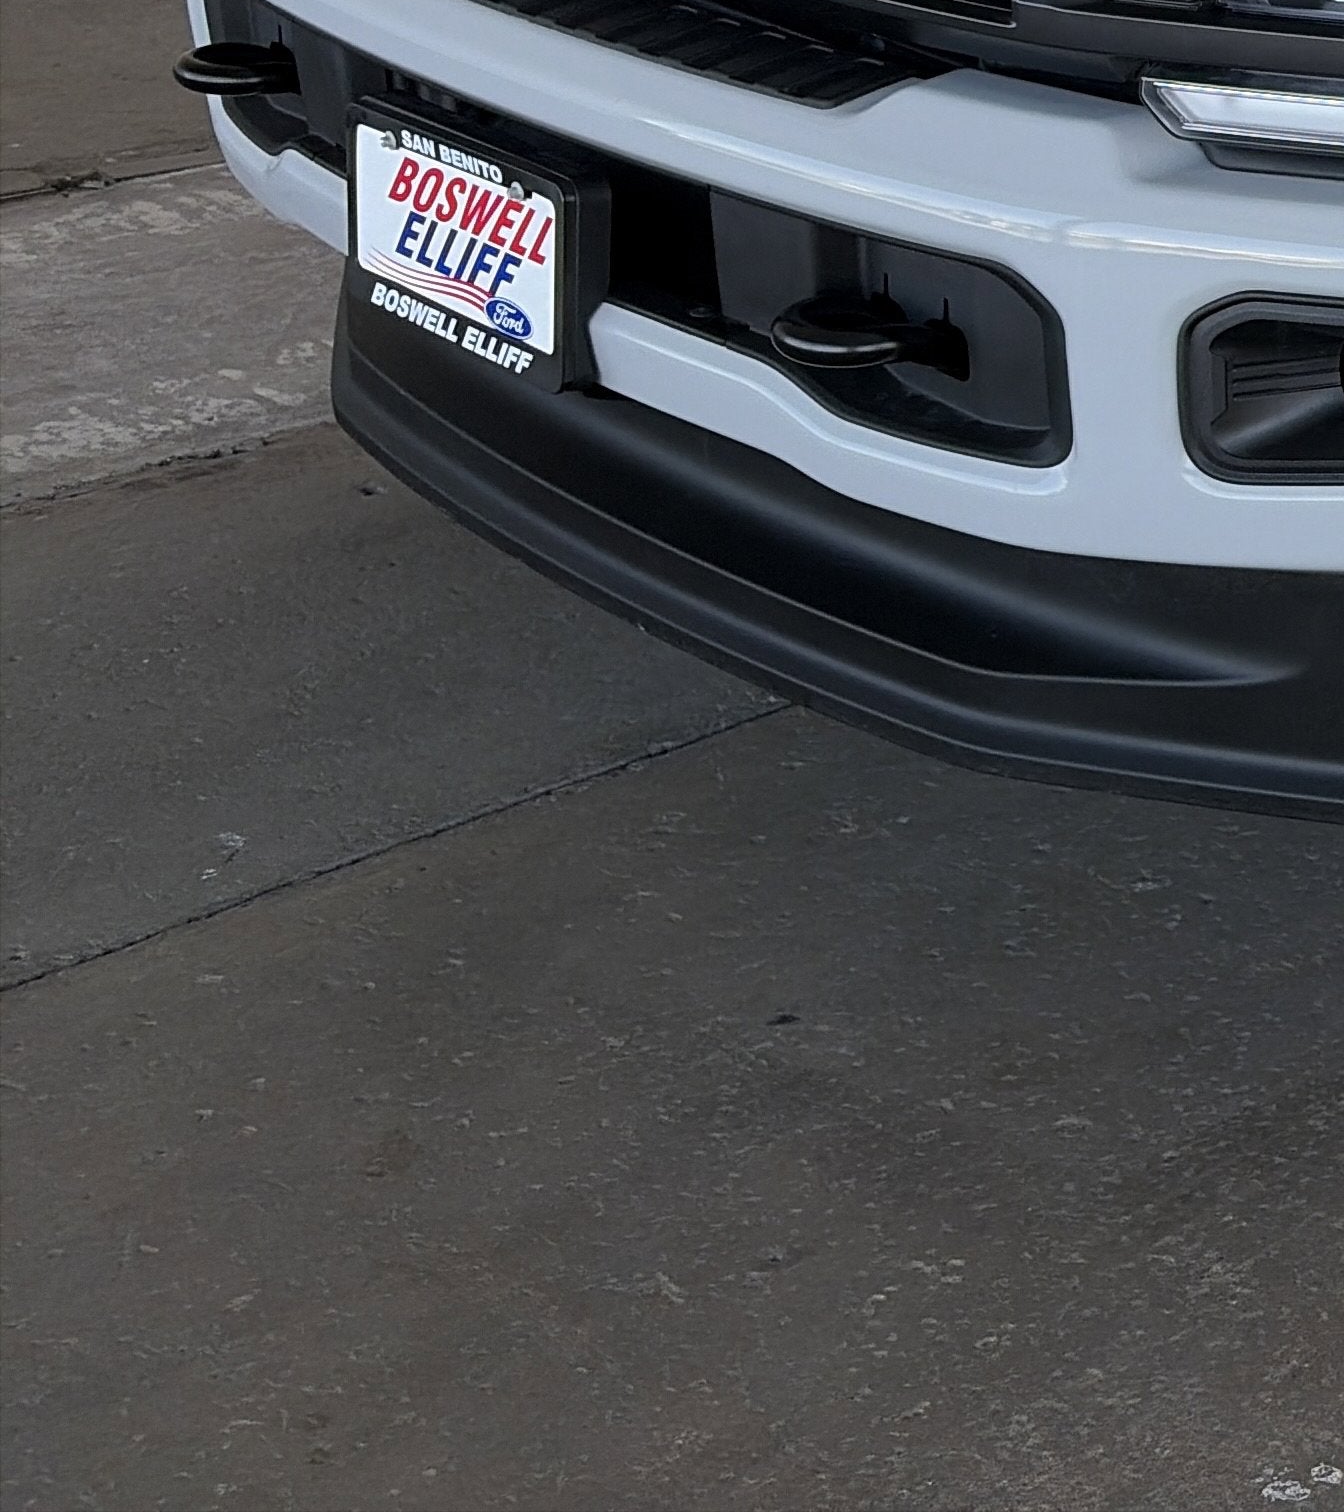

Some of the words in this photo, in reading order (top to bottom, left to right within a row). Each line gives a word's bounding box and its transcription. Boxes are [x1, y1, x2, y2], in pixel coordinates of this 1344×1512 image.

[401, 129, 436, 159] SAN
[439, 143, 503, 184] BENITO
[388, 156, 553, 265] BOSWELL
[395, 210, 523, 296] ELLIFF
[370, 282, 459, 343] BOSWELL
[461, 326, 534, 375] ELLIFF
[492, 303, 525, 335] Ford
